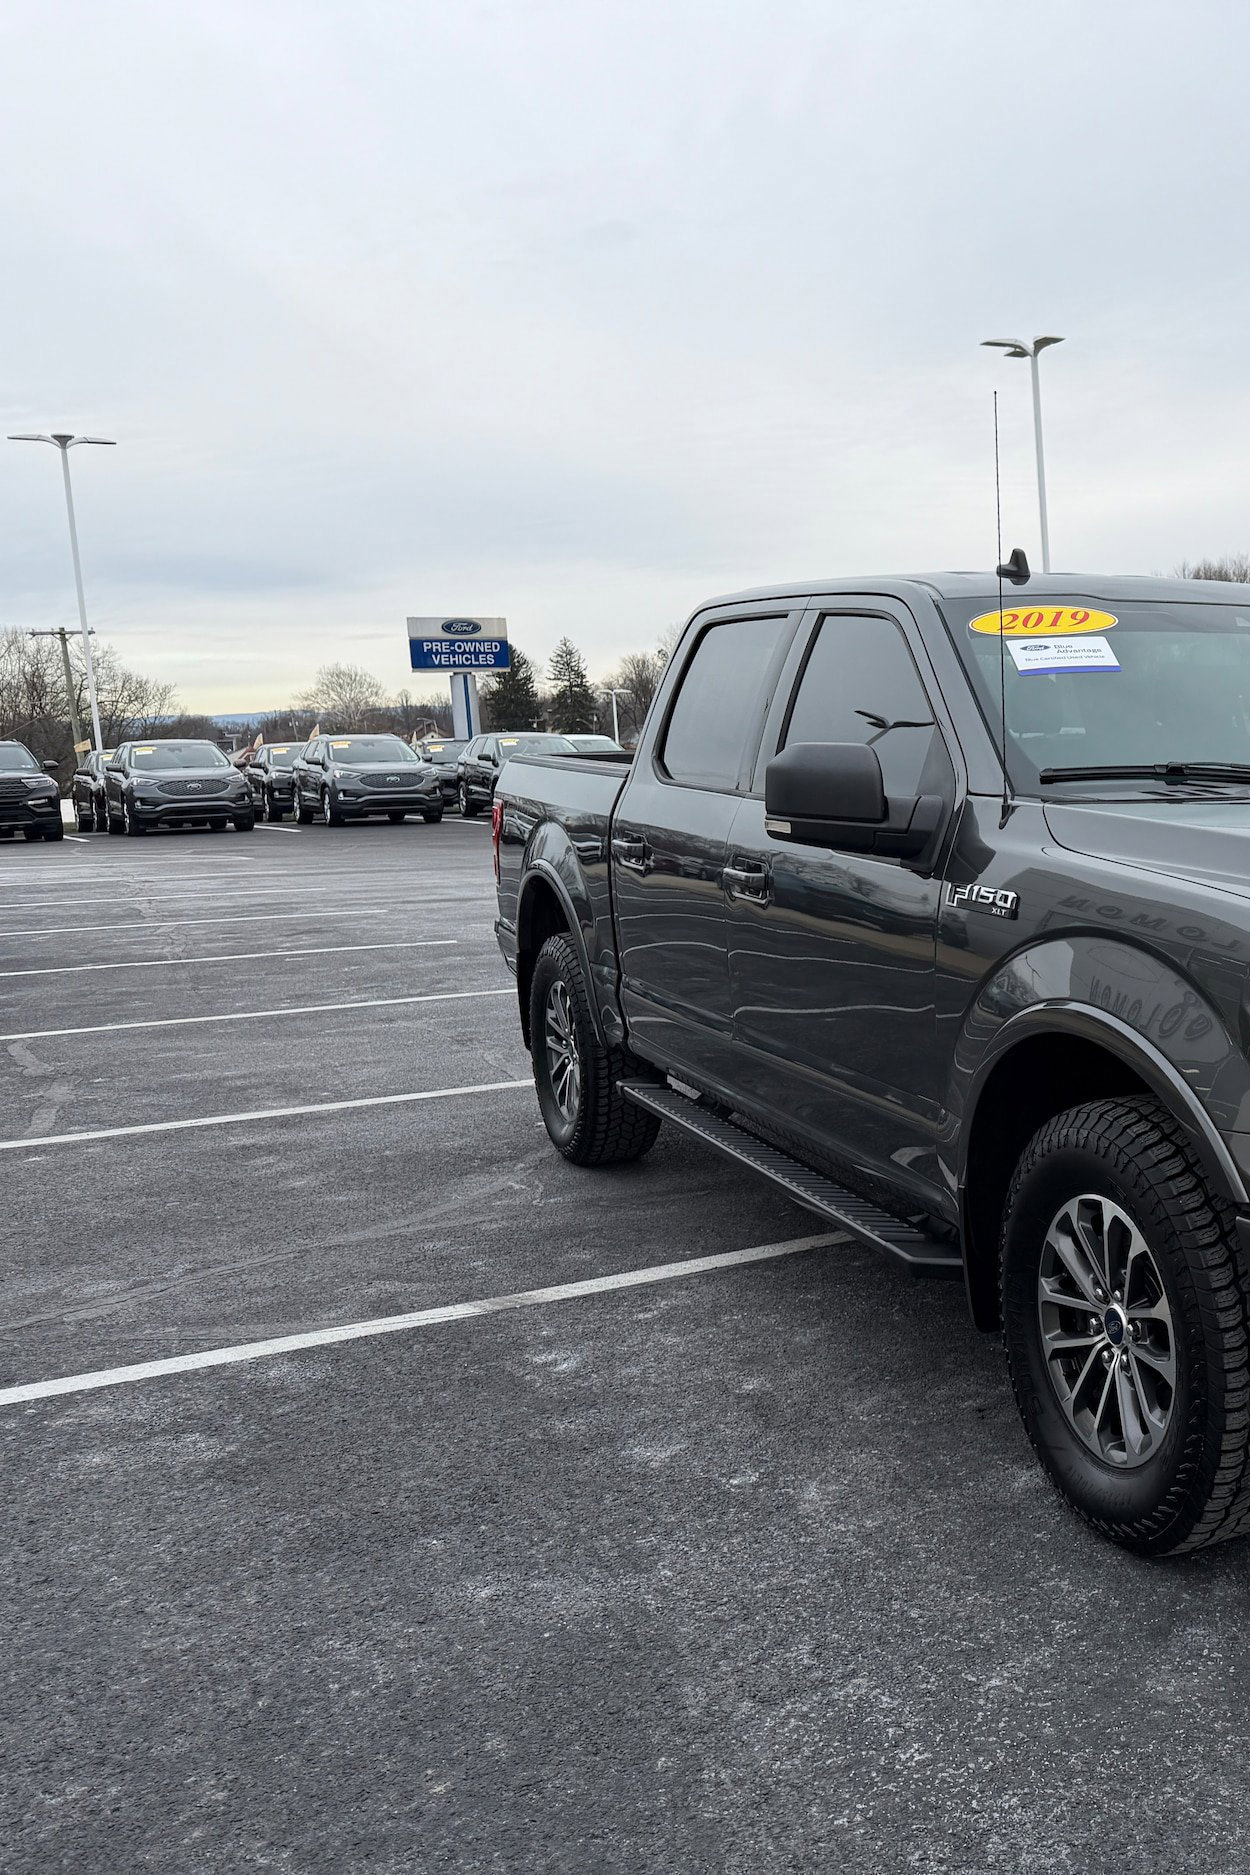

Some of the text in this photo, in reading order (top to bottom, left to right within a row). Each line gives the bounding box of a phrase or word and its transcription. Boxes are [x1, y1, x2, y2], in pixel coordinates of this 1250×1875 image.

[997, 610, 1090, 631] 2019
[450, 622, 475, 632] Ford
[423, 642, 500, 653] PRE-OWNED
[432, 654, 495, 665] VEHICLES
[991, 907, 1007, 916] XLT
